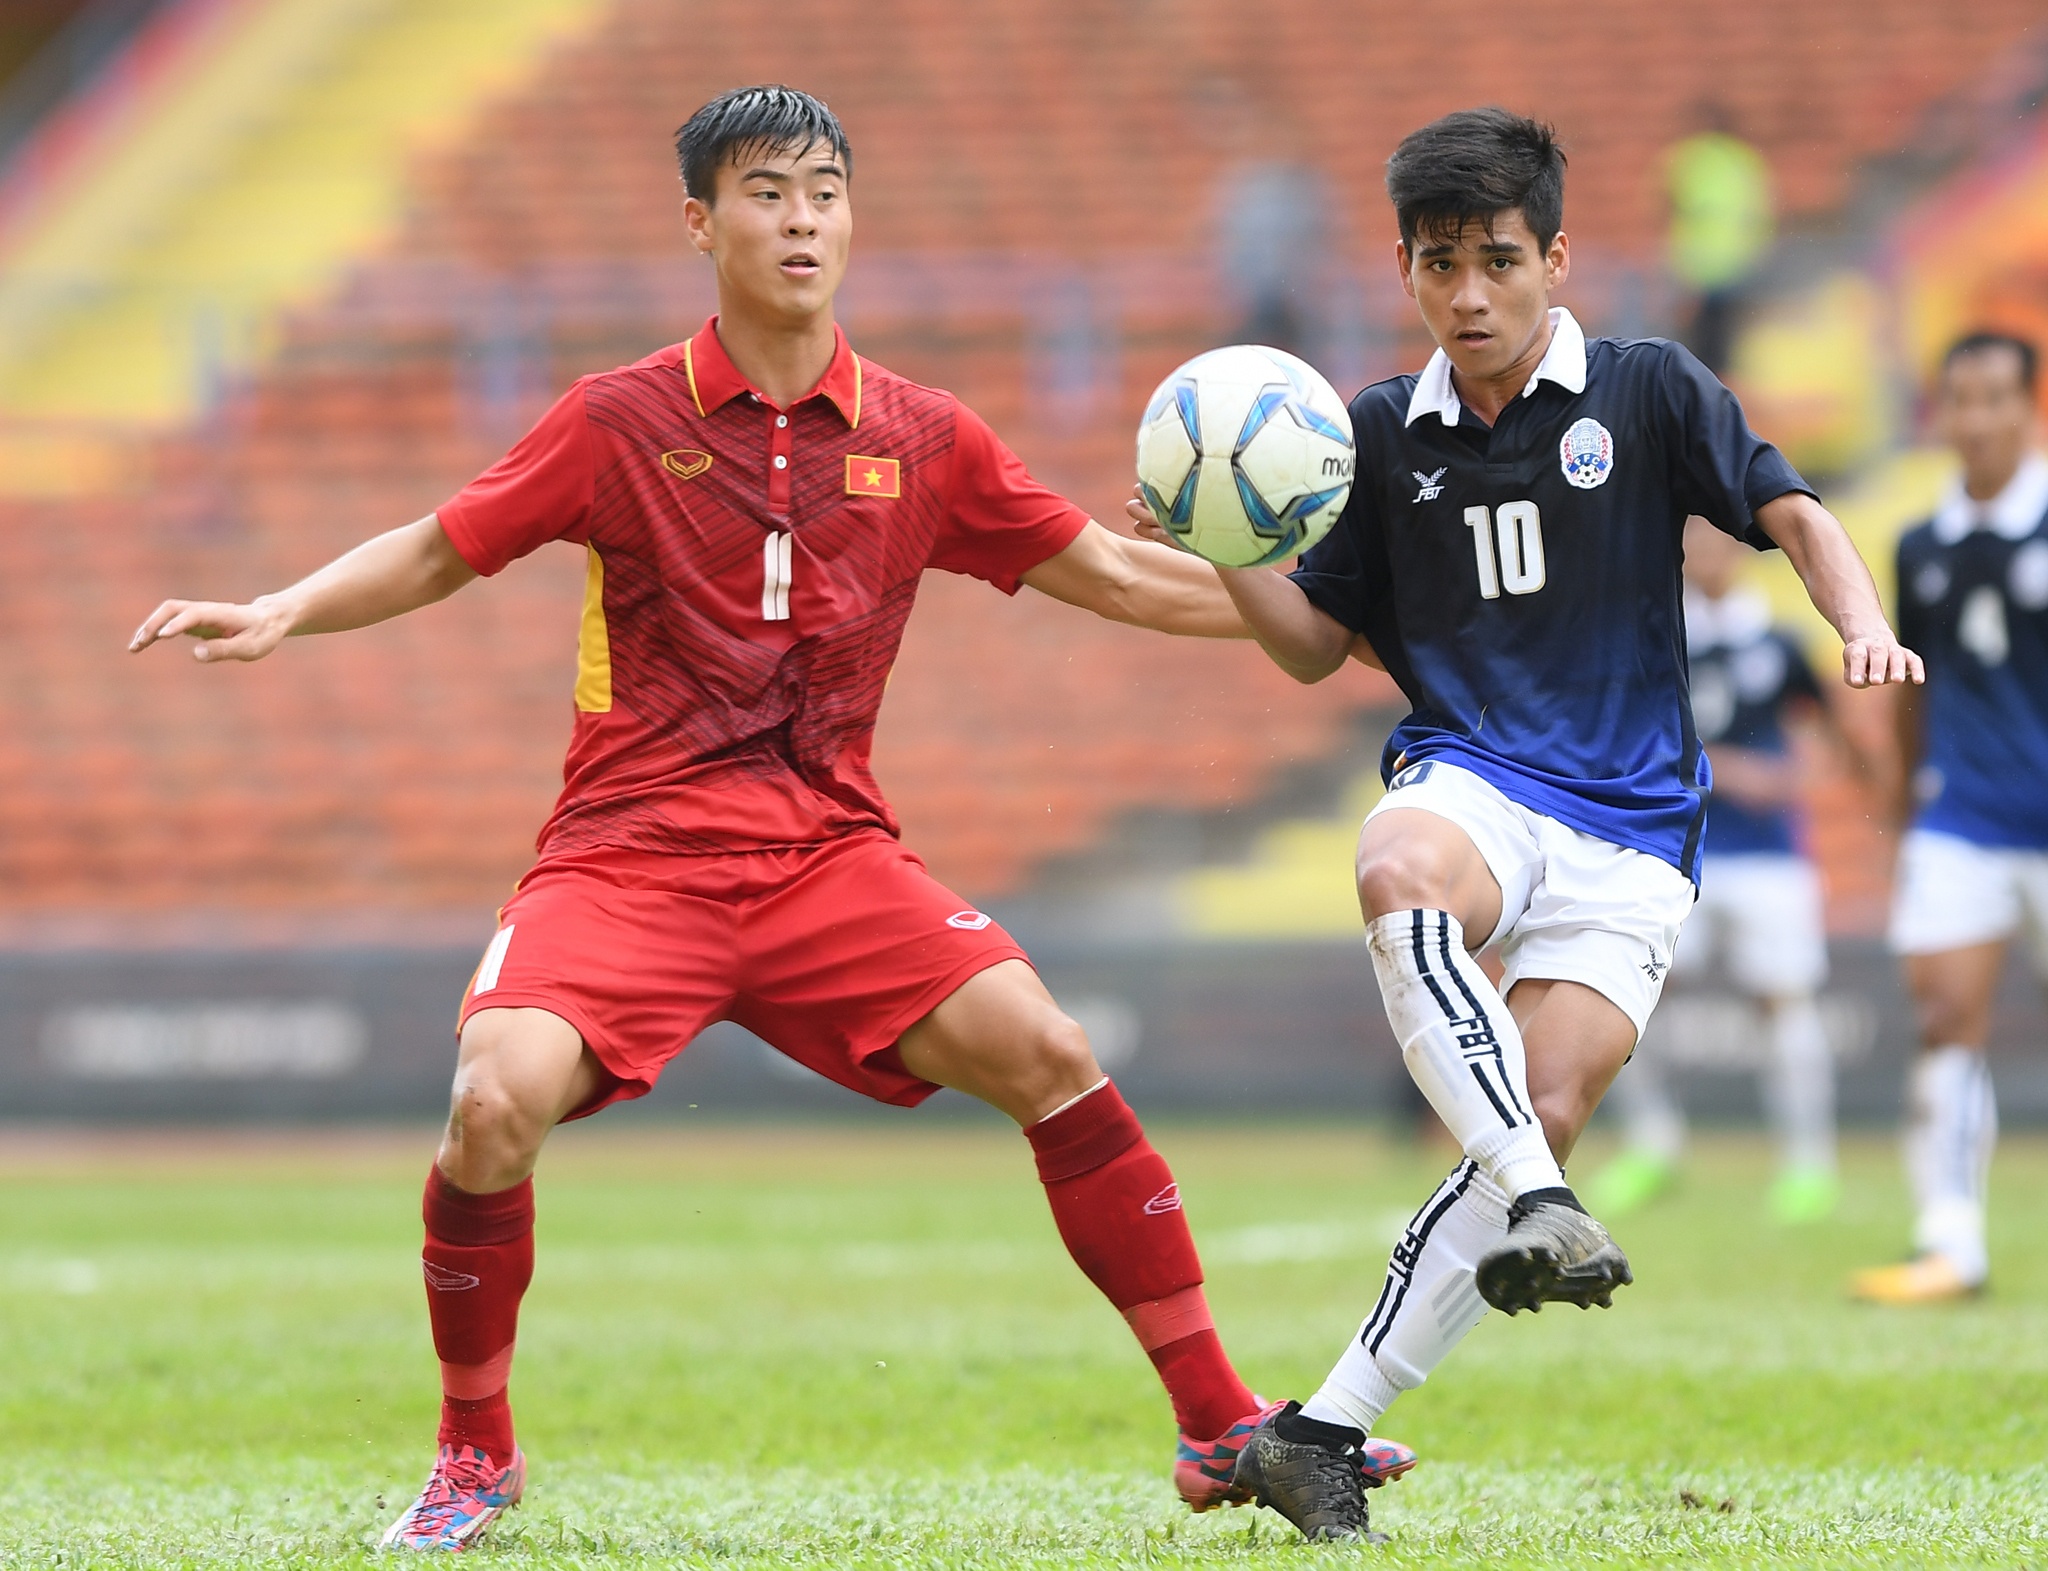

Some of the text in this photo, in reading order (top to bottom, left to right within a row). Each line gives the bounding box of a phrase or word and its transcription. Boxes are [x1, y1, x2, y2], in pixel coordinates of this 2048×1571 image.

[1412, 485, 1445, 503] FBT
[763, 531, 792, 621] 11
[1464, 500, 1546, 600] 10
[1450, 1015, 1502, 1059] FBT
[1389, 1228, 1426, 1289] FBT
